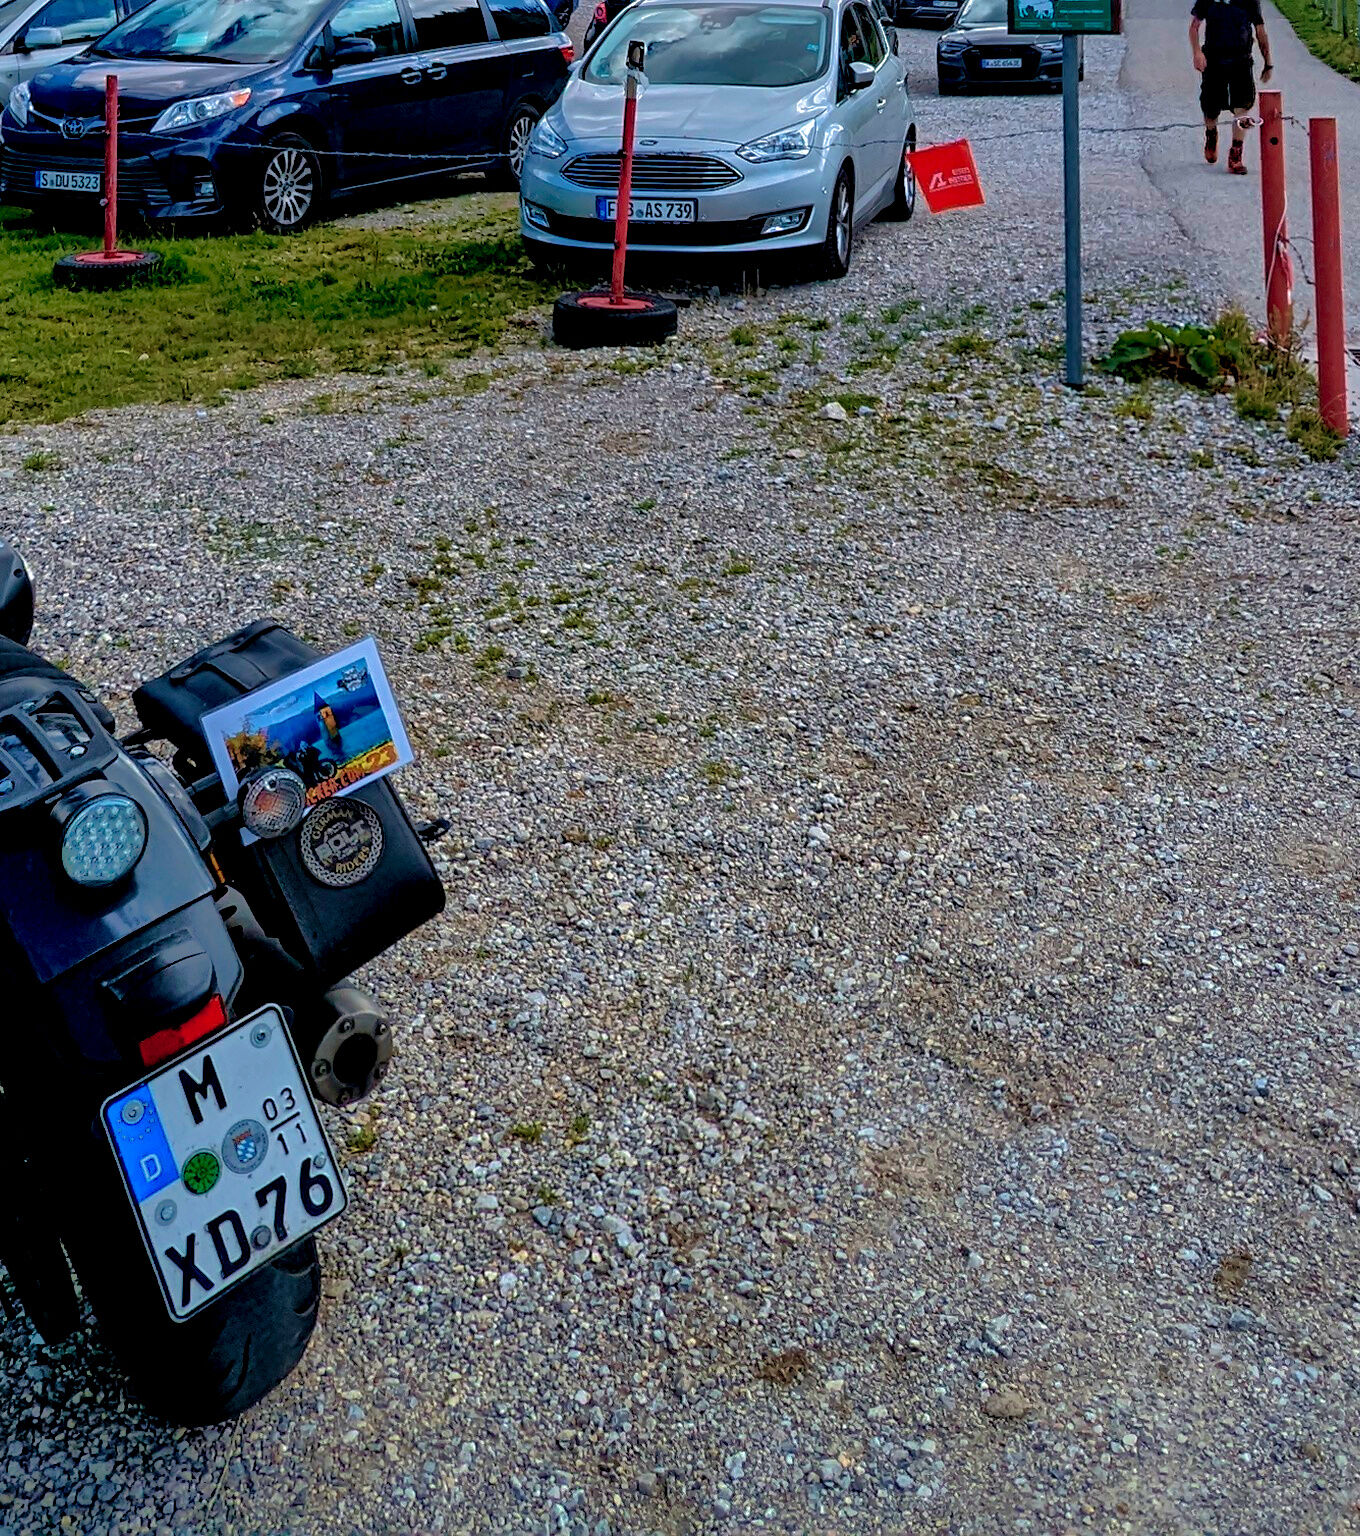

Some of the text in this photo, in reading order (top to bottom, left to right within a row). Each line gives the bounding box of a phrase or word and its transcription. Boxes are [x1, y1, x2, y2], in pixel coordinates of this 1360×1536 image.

[41, 173, 48, 186] S
[71, 175, 99, 189] 5323
[645, 202, 662, 218] AS
[666, 203, 692, 219] 739
[311, 808, 354, 840] GERMAN
[178, 1054, 227, 1125] M
[262, 1087, 296, 1121] 03
[276, 1122, 308, 1155] 11
[140, 1153, 163, 1183] D
[164, 1157, 334, 1308] XD 76
